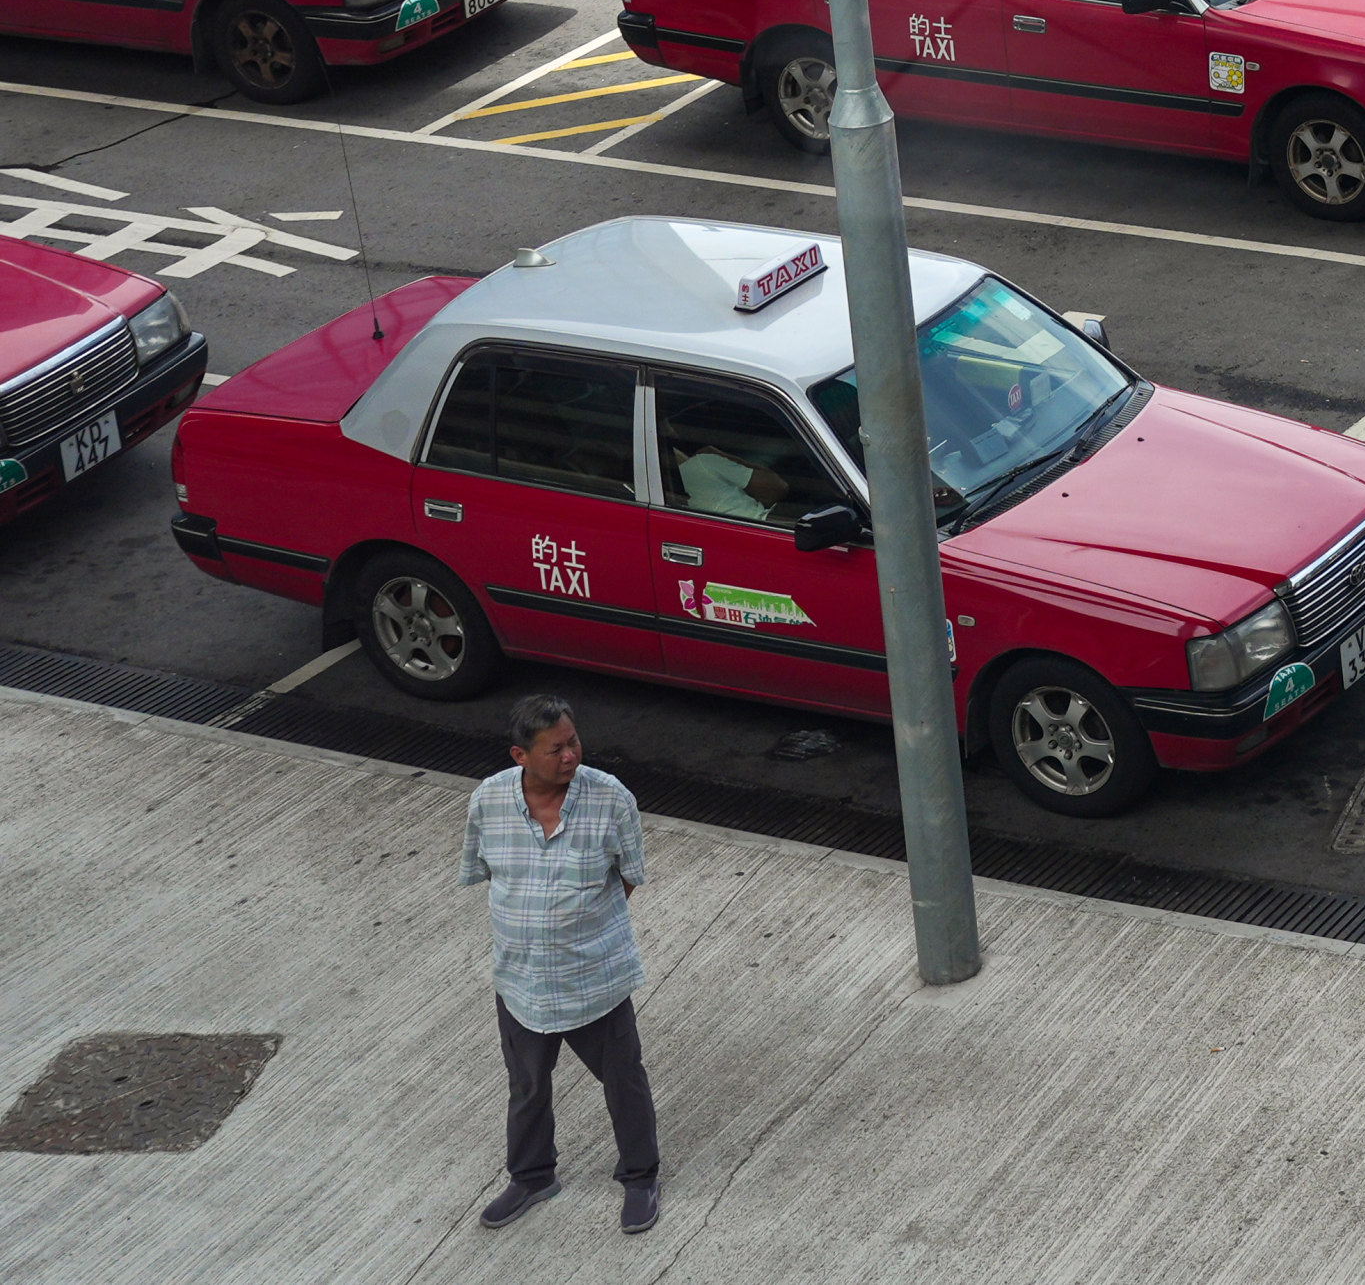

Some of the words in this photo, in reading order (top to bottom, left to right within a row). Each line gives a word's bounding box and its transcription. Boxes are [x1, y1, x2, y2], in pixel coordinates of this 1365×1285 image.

[404, 10, 433, 25] SEATS
[413, 2, 421, 14] 4
[909, 13, 953, 39] 的士
[909, 35, 955, 61] TAXI
[757, 244, 819, 296] TAXI
[1009, 390, 1022, 407] TAXI
[74, 435, 109, 474] 447
[531, 534, 591, 569] 的士
[533, 562, 591, 598] TAXI
[1274, 665, 1297, 683] TAXI
[1285, 677, 1295, 693] 4
[1274, 684, 1307, 710] SEATS
